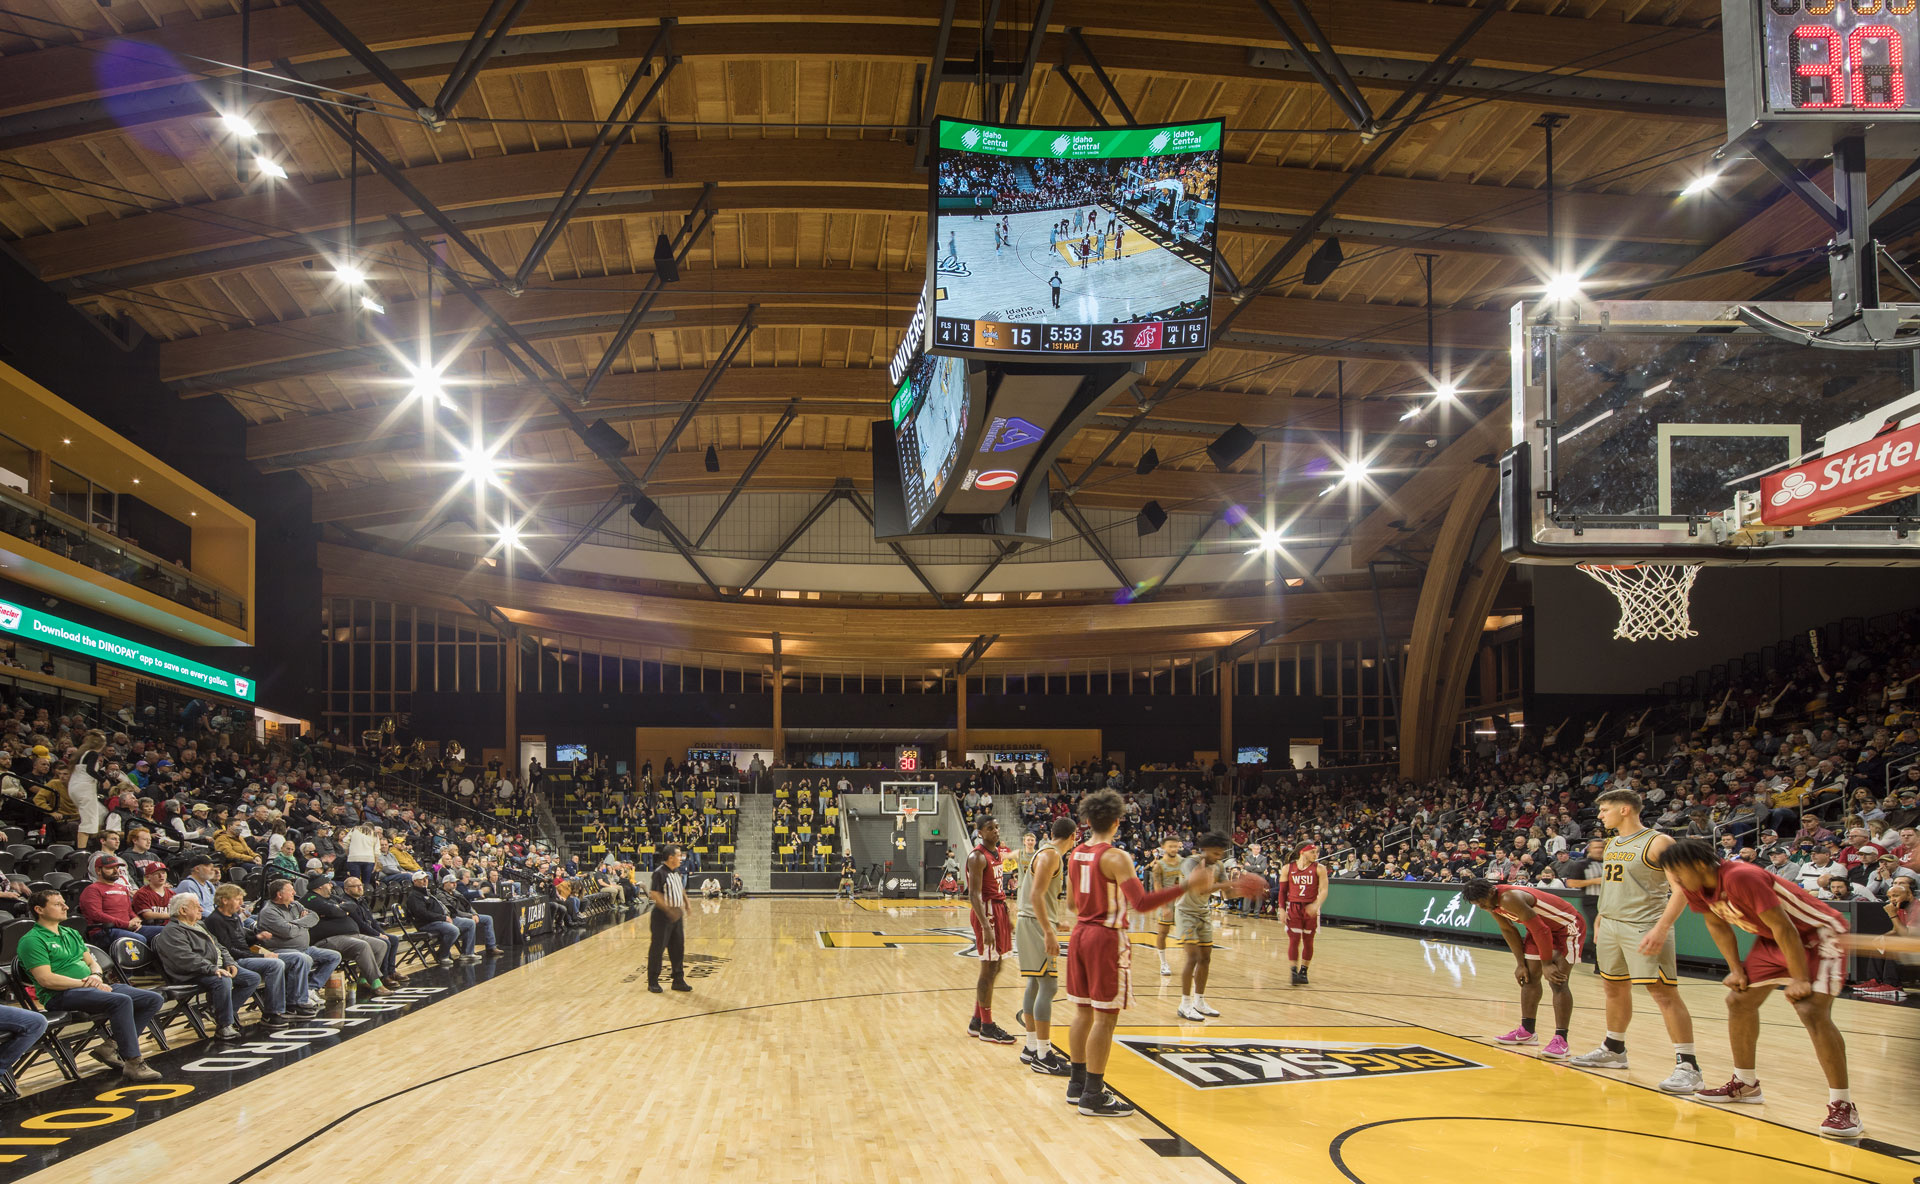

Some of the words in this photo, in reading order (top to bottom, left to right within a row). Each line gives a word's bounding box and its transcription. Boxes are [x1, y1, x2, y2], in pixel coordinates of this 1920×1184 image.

[1789, 24, 1905, 109] 30
[983, 131, 1001, 140] Idaho
[1173, 130, 1195, 138] Idaho
[983, 138, 1008, 148] Central
[1073, 136, 1093, 144] Idaho
[1172, 136, 1201, 146] Central
[1073, 142, 1100, 151] Central
[1101, 203, 1162, 240] UIVERSITY
[1005, 305, 1033, 315] Idaho
[1007, 308, 1046, 320] Central
[940, 321, 951, 329] FLS
[960, 323, 971, 331] TOL
[1167, 325, 1179, 333] TOL
[1189, 324, 1201, 332] FLS
[942, 331, 949, 341] 4
[962, 332, 969, 343] 3
[1011, 328, 1031, 345] 15
[1050, 327, 1082, 341] 5:53
[1101, 330, 1123, 346] 35
[1190, 333, 1198, 343] 9
[1168, 334, 1176, 345] 4
[1052, 342, 1063, 350] 1ST
[1064, 342, 1079, 350] HALF
[33, 619, 81, 643] Download
[82, 635, 96, 648] the
[140, 654, 154, 666] app
[155, 657, 163, 667] to
[164, 662, 179, 672] save
[181, 667, 189, 675] on
[190, 670, 208, 683] every
[209, 676, 229, 687] gallon.
[900, 758, 916, 770] 30
[1605, 863, 1624, 883] 32
[1292, 875, 1313, 885] WSU
[1298, 885, 1306, 897] 2
[181, 1017, 372, 1072] FORD
